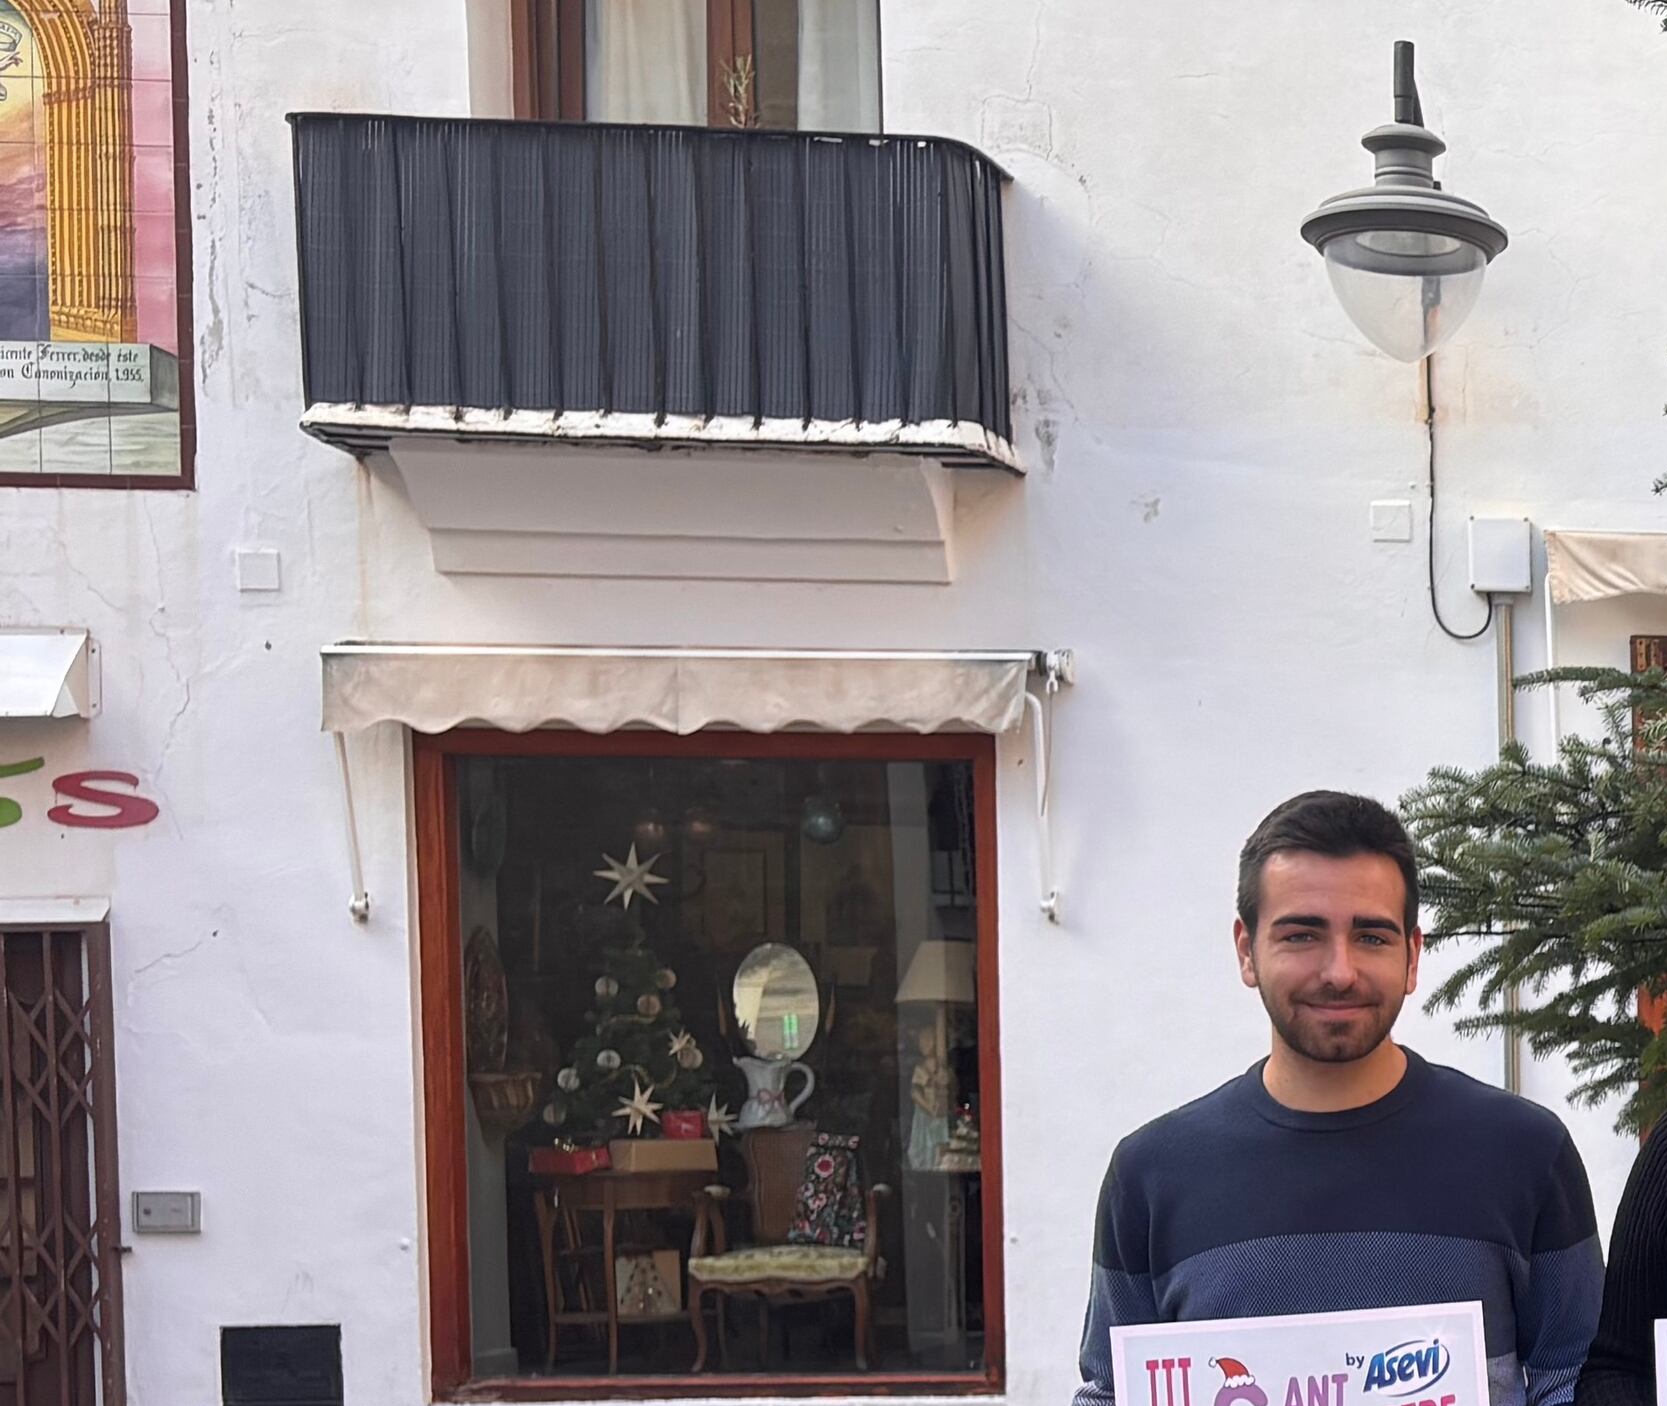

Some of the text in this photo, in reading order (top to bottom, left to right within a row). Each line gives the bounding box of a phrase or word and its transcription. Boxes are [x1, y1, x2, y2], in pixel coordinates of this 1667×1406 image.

[0, 346, 32, 360] icente
[1345, 1337, 1443, 1393] by Asevi
